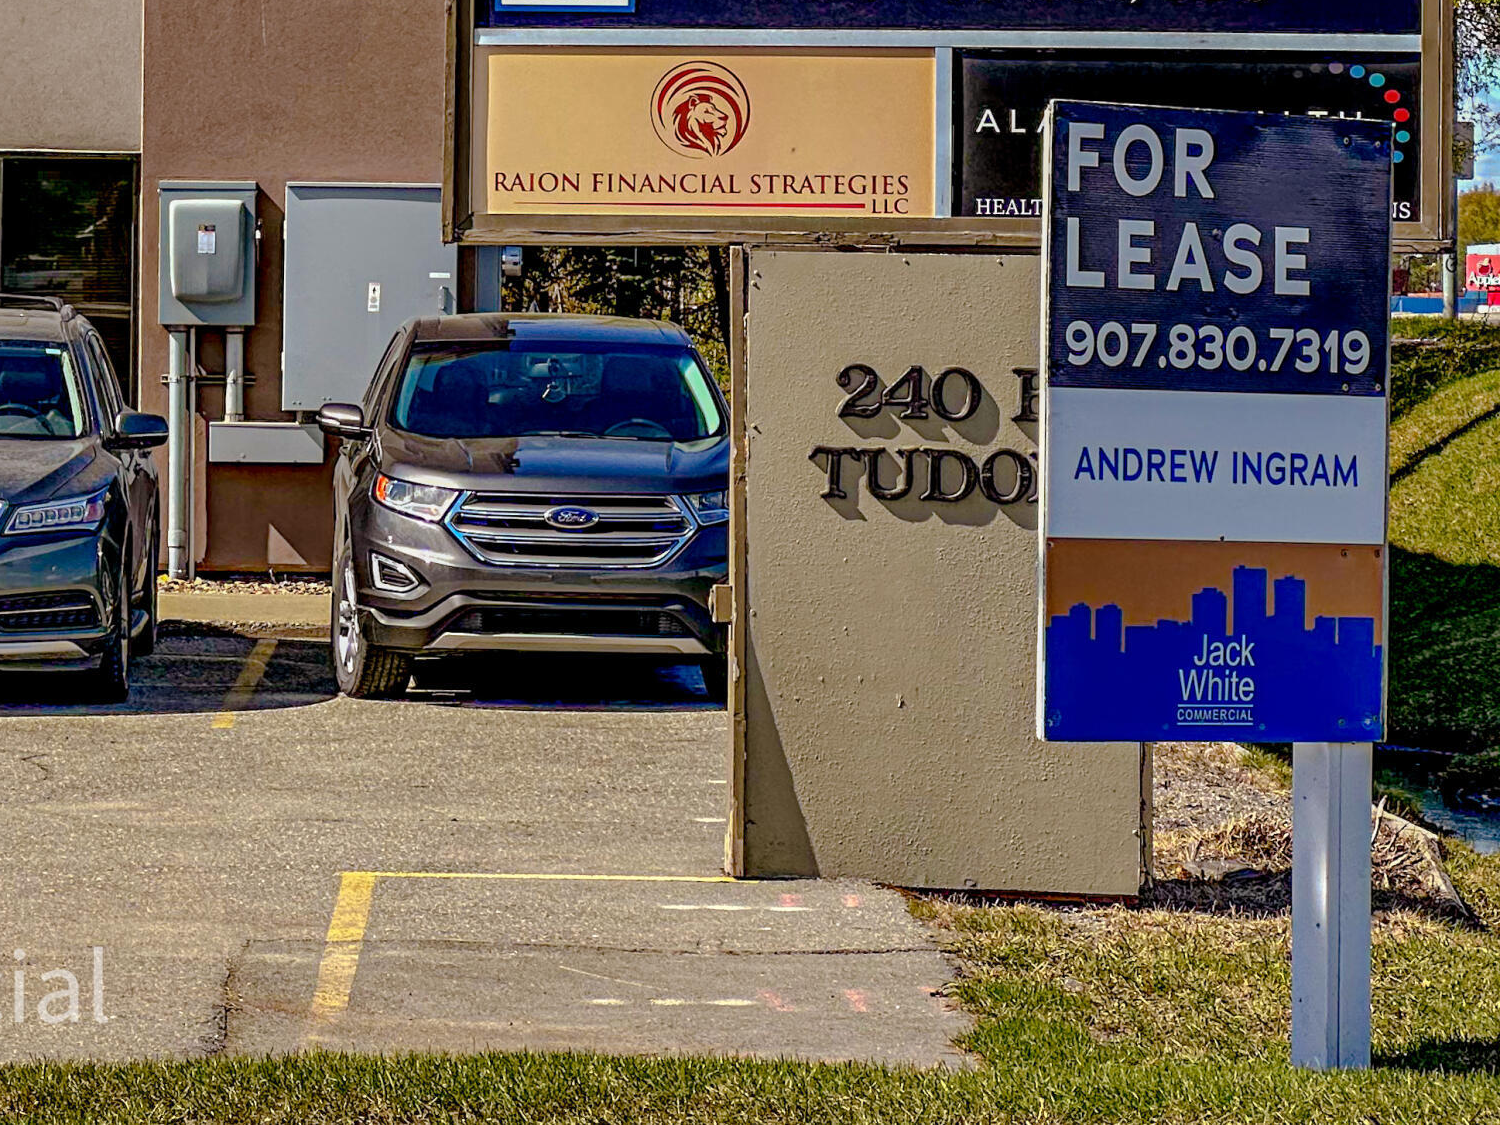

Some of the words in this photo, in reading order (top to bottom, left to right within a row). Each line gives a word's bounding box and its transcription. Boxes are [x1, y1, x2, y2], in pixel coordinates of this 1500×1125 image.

[1067, 121, 1217, 199] FOR
[494, 171, 581, 193] RAION
[591, 172, 740, 194] FINANCIAL
[749, 174, 909, 196] STRATEGIES
[871, 198, 909, 215] LLC
[1065, 216, 1312, 297] LEASE
[1065, 319, 1371, 375] 907.830.7319
[835, 363, 982, 422] 240
[808, 446, 1039, 504] TUDO
[1074, 446, 1219, 483] ANDREW
[1232, 450, 1359, 487] INGRAM
[1193, 634, 1255, 667] Jack
[1178, 668, 1255, 702] White
[1176, 708, 1254, 722] COMMERCIAL
